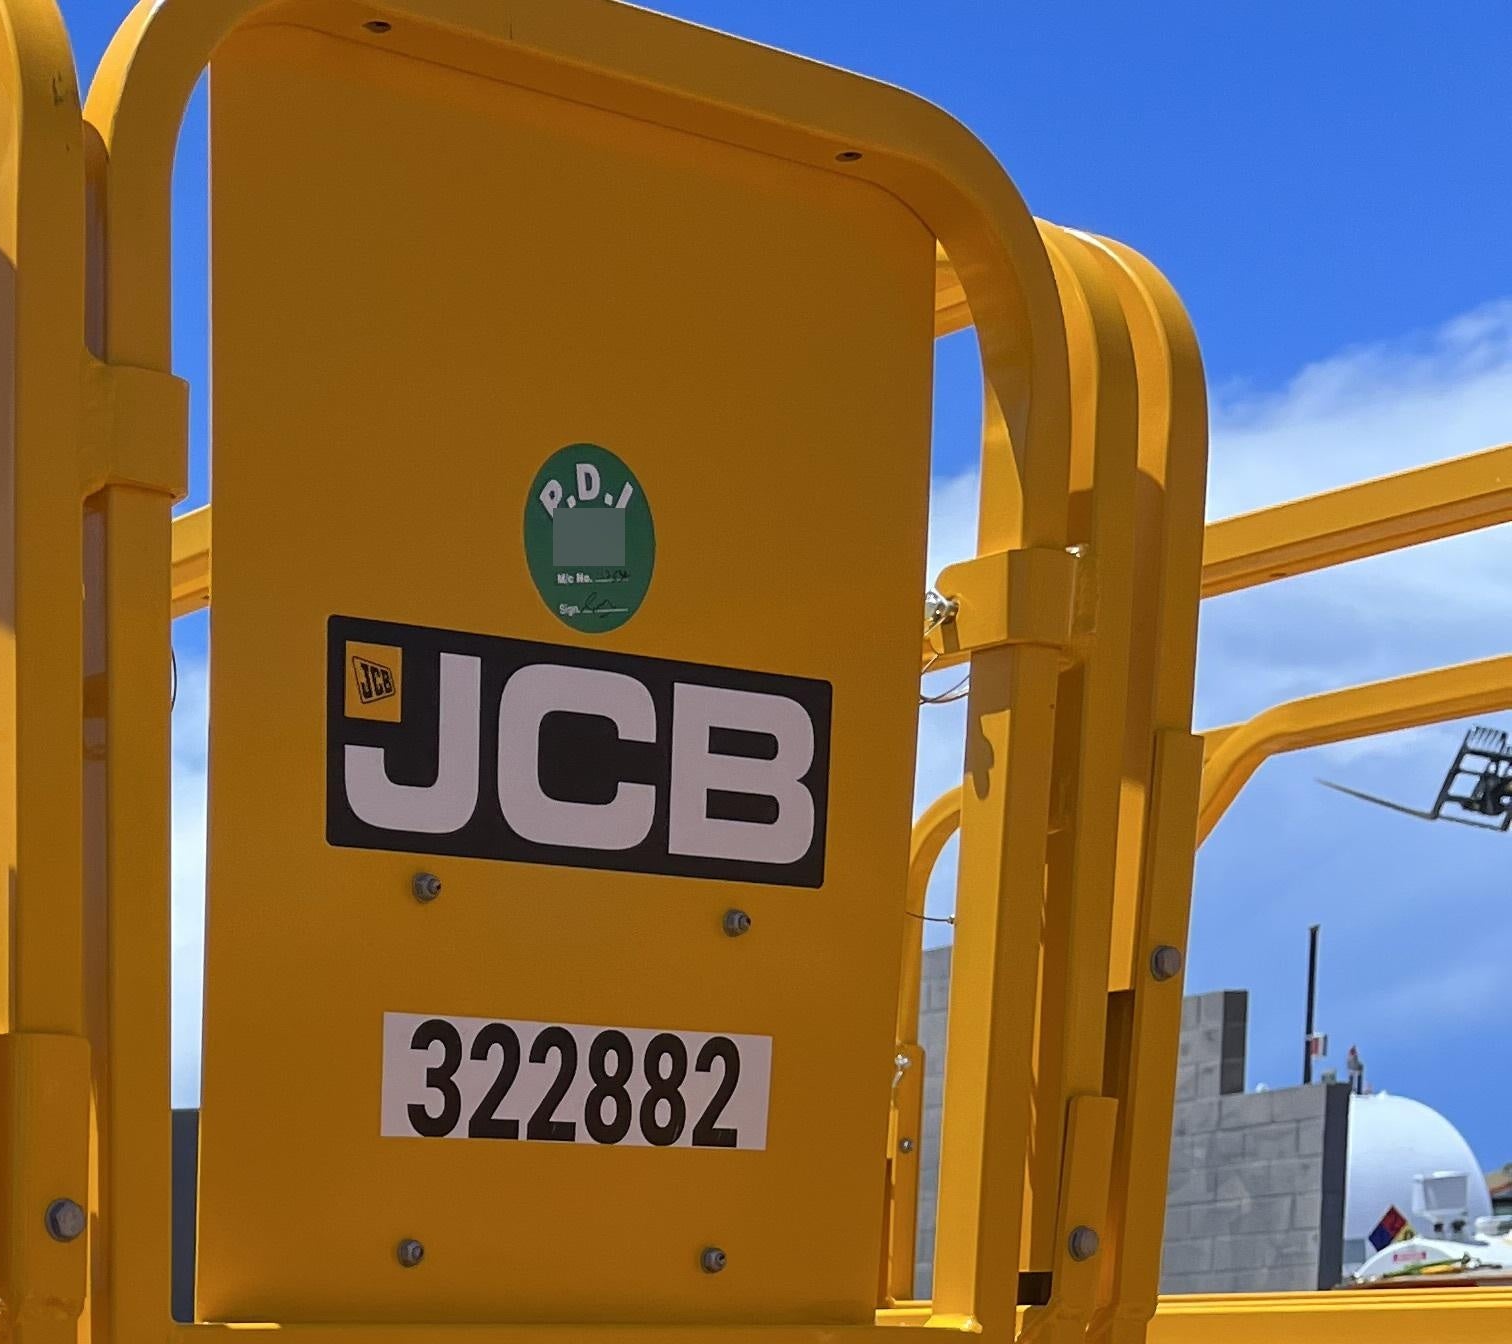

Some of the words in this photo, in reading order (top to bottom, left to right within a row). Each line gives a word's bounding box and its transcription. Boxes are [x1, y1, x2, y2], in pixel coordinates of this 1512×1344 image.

[576, 572, 593, 584] No.
[360, 662, 394, 699] JCB
[344, 651, 815, 865] JCB
[407, 1018, 741, 1149] 322882
